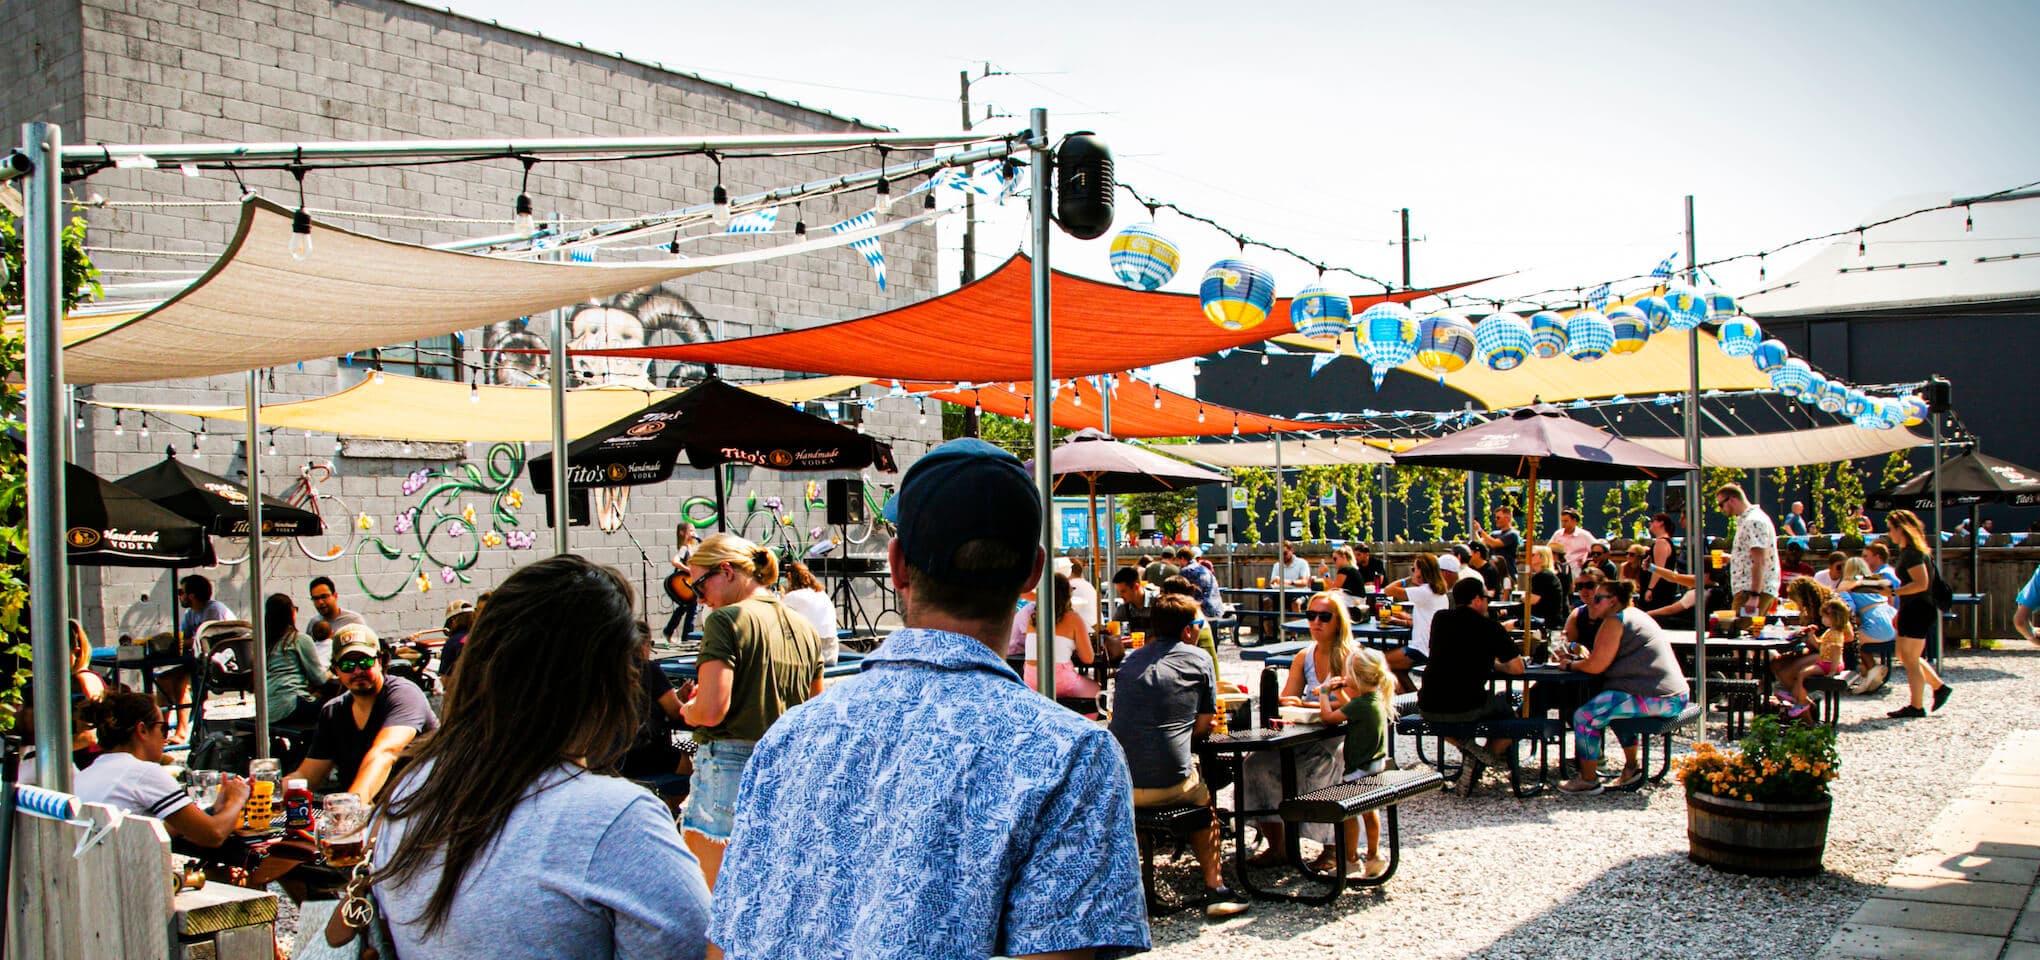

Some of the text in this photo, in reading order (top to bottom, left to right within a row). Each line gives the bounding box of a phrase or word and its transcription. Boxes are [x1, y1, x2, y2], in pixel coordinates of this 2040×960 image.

[720, 447, 839, 464] Tito's Handmade
[801, 458, 835, 466] VODKA
[567, 461, 661, 482] Tito's Handmade
[1915, 498, 1937, 509] Tito
[231, 520, 249, 533] Tit
[103, 528, 160, 543] Handmade
[110, 541, 154, 550] VODKA
[345, 903, 371, 922] MK
